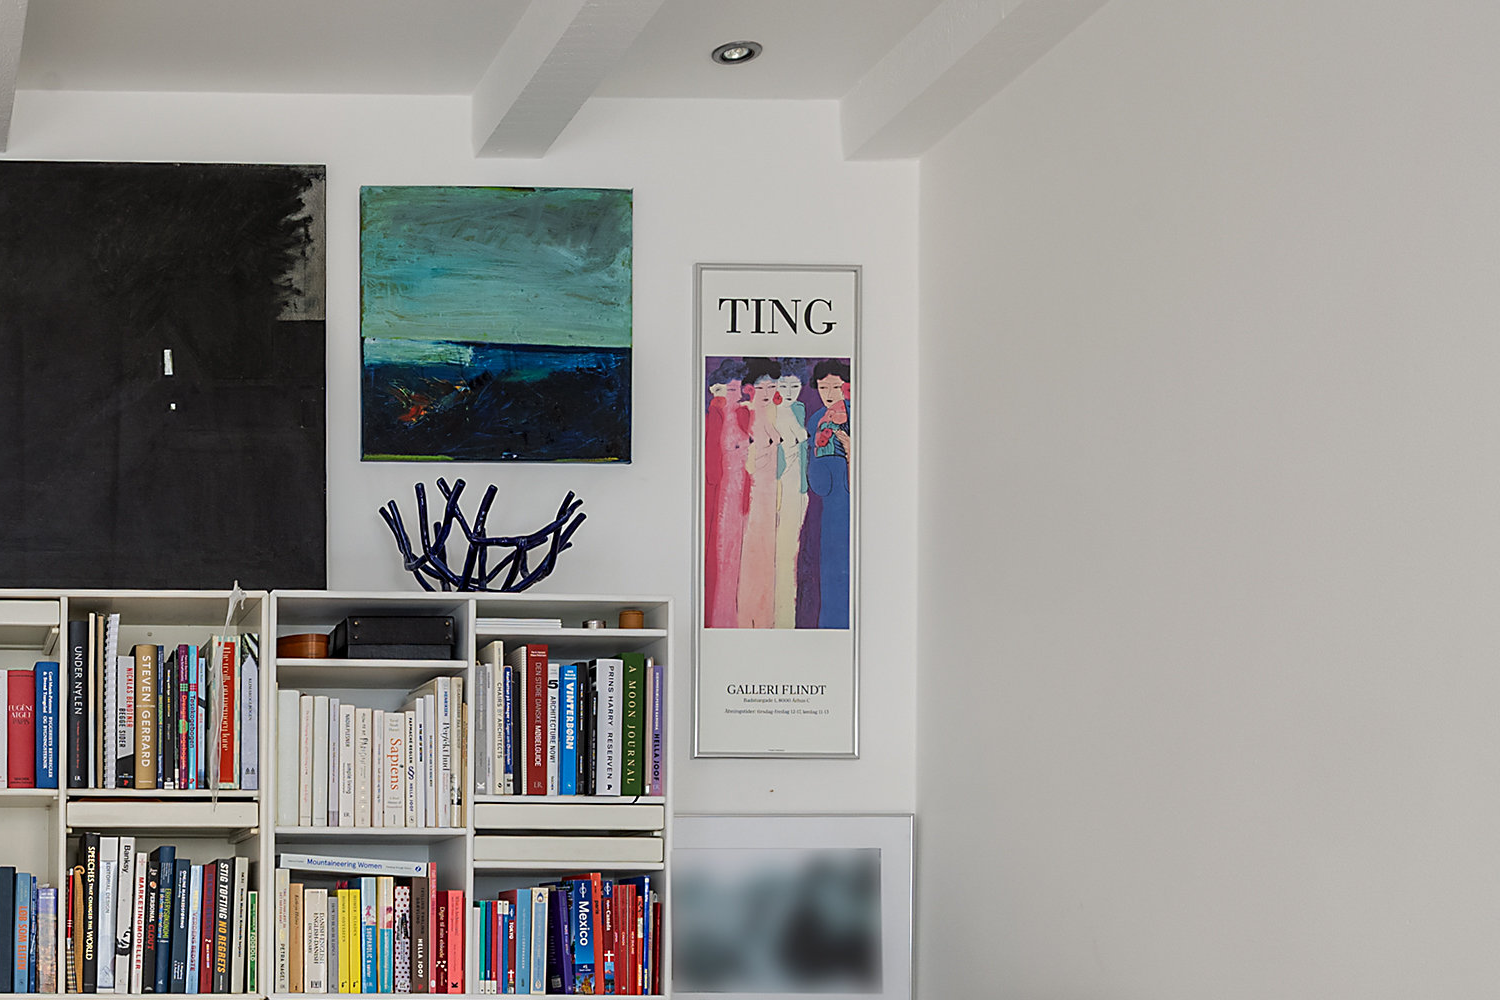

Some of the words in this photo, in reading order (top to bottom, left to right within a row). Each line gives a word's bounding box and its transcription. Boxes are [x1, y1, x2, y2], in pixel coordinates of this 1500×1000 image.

[718, 298, 836, 334] TING
[142, 656, 151, 702] STEVEN
[548, 680, 558, 690] 5
[727, 684, 778, 694] GALLERI
[782, 684, 826, 695] FLINDT
[566, 682, 574, 750] VINTERBØRN
[628, 680, 636, 722] MOON
[142, 710, 151, 768] GERRARD
[627, 726, 636, 784] JOURNAL
[386, 738, 402, 790] Sapiens
[220, 862, 228, 882] STIG
[307, 858, 356, 869] Mountaineering
[18, 906, 27, 922] LØB
[162, 888, 171, 939] ERHVERVSØKONOMI
[219, 884, 228, 919] TØFTING
[18, 924, 27, 943] SOM
[136, 876, 144, 970] MARKETINGMODELLER
[218, 920, 226, 932] NO
[578, 900, 590, 946] Mexico
[18, 945, 27, 970] ELITEN
[86, 930, 94, 960] WORLD
[217, 934, 226, 973] REGRETS
